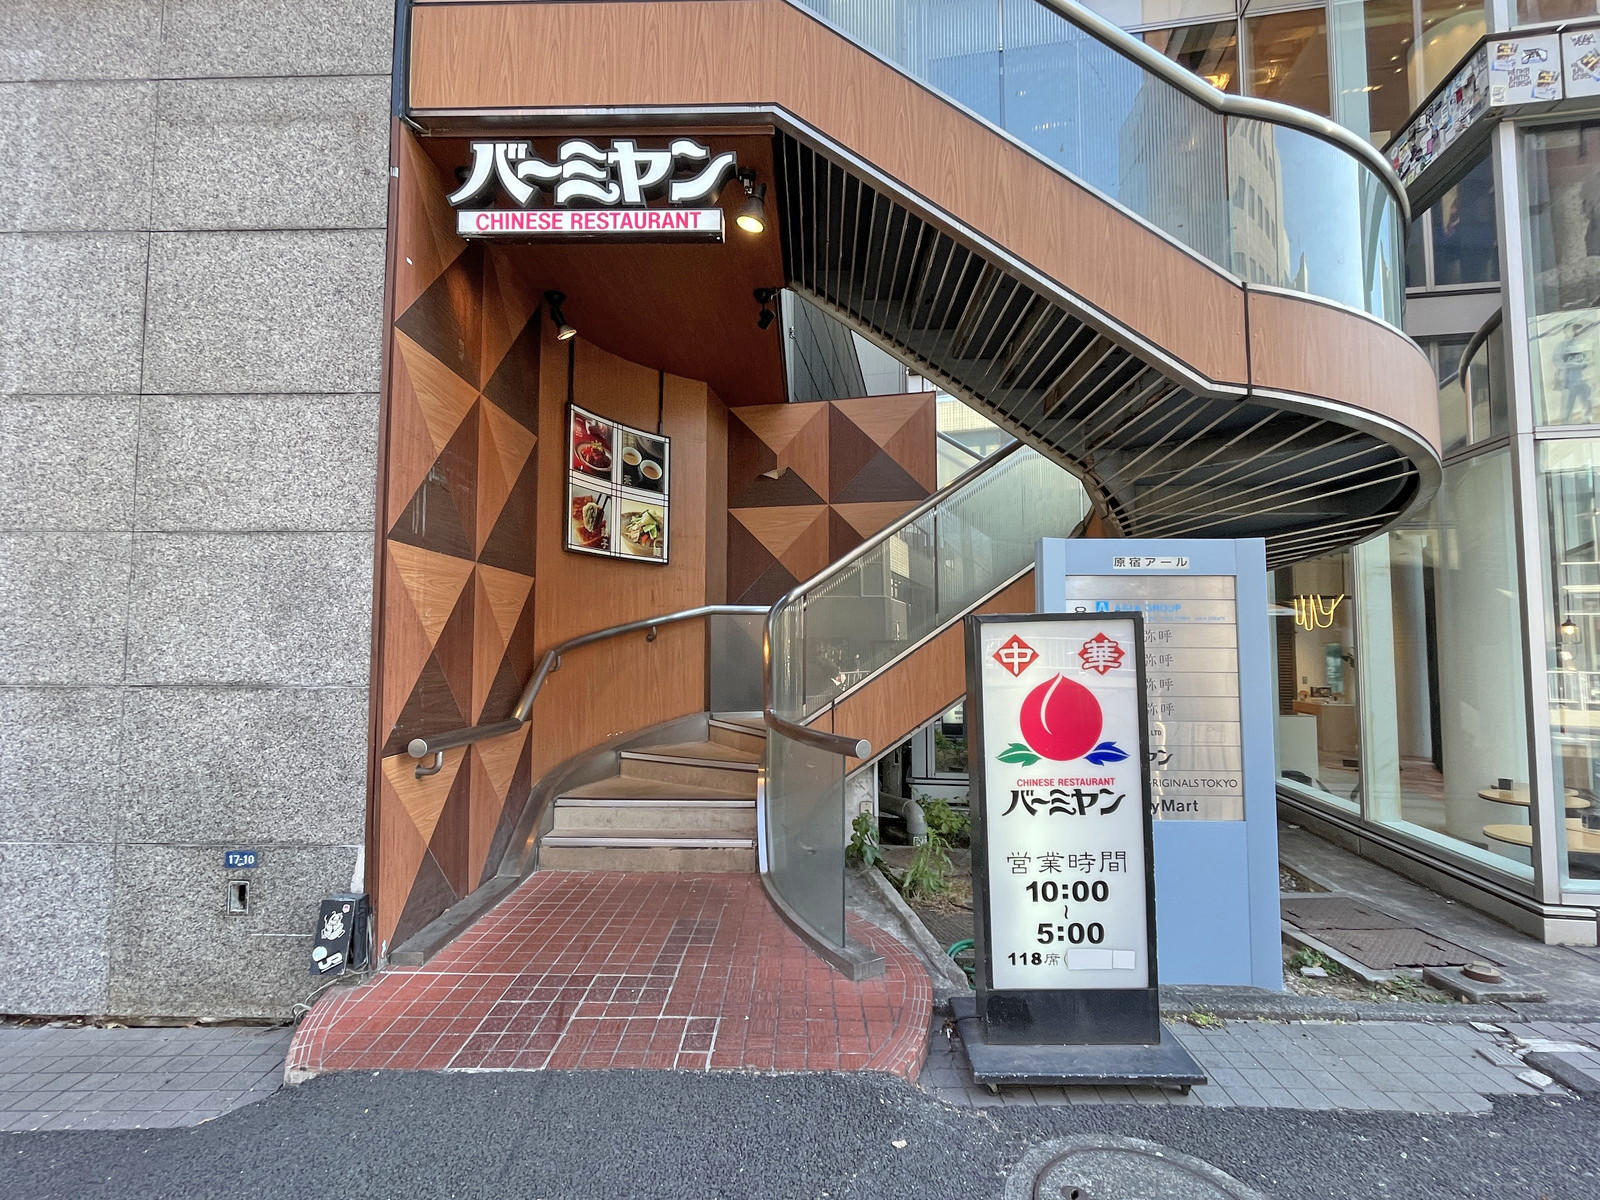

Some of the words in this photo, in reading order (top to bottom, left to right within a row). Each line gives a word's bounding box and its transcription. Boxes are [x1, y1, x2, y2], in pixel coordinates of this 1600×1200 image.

[448, 140, 735, 204] バーミヤン
[475, 212, 563, 231] CHINESE
[570, 211, 702, 231] RESTAURANT
[1113, 557, 1188, 568] 原宿アール
[998, 641, 1035, 675] 中
[1081, 639, 1122, 673] 華
[1016, 778, 1055, 788] CHINESE
[1057, 777, 1116, 787] RESTAURANT
[1151, 779, 1199, 788] RIGINALS
[1200, 779, 1238, 788] TOKYO
[1001, 788, 1126, 817] バーミヤン
[228, 854, 255, 866] 17-10
[1006, 851, 1127, 875] 営業時間
[1025, 880, 1110, 903] 10:00
[1036, 922, 1105, 945] 5:00
